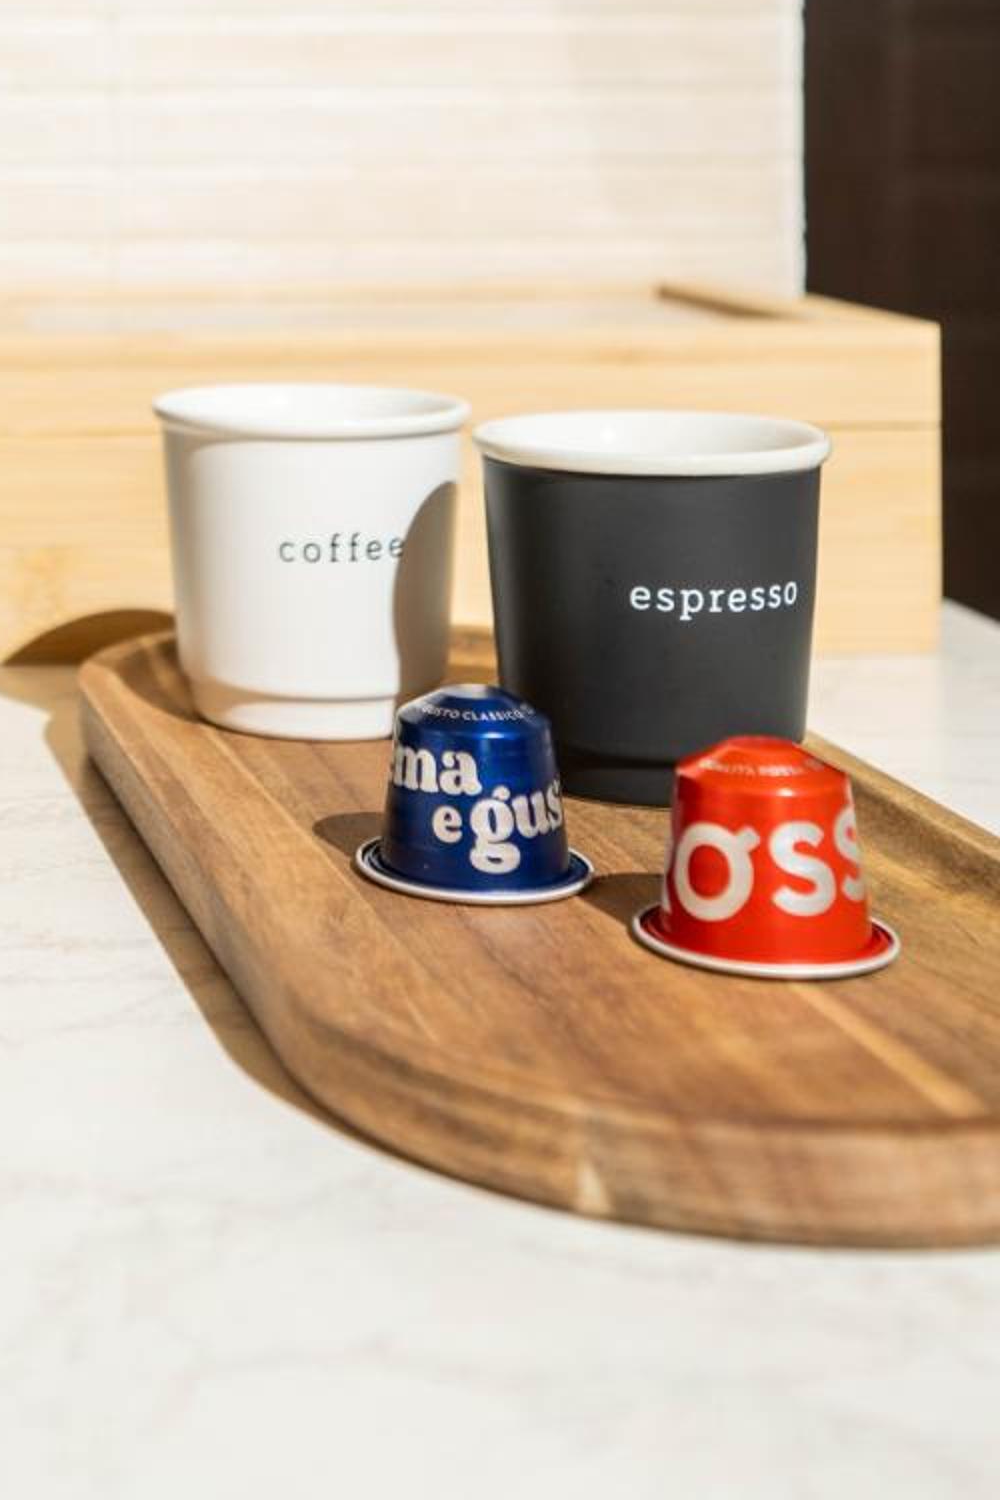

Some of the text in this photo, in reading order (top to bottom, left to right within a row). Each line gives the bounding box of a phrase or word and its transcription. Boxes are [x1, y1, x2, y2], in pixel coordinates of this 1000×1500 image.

[278, 532, 405, 564] coffee
[629, 581, 798, 621] espresso
[431, 804, 464, 844] e
[662, 803, 866, 922] oss
